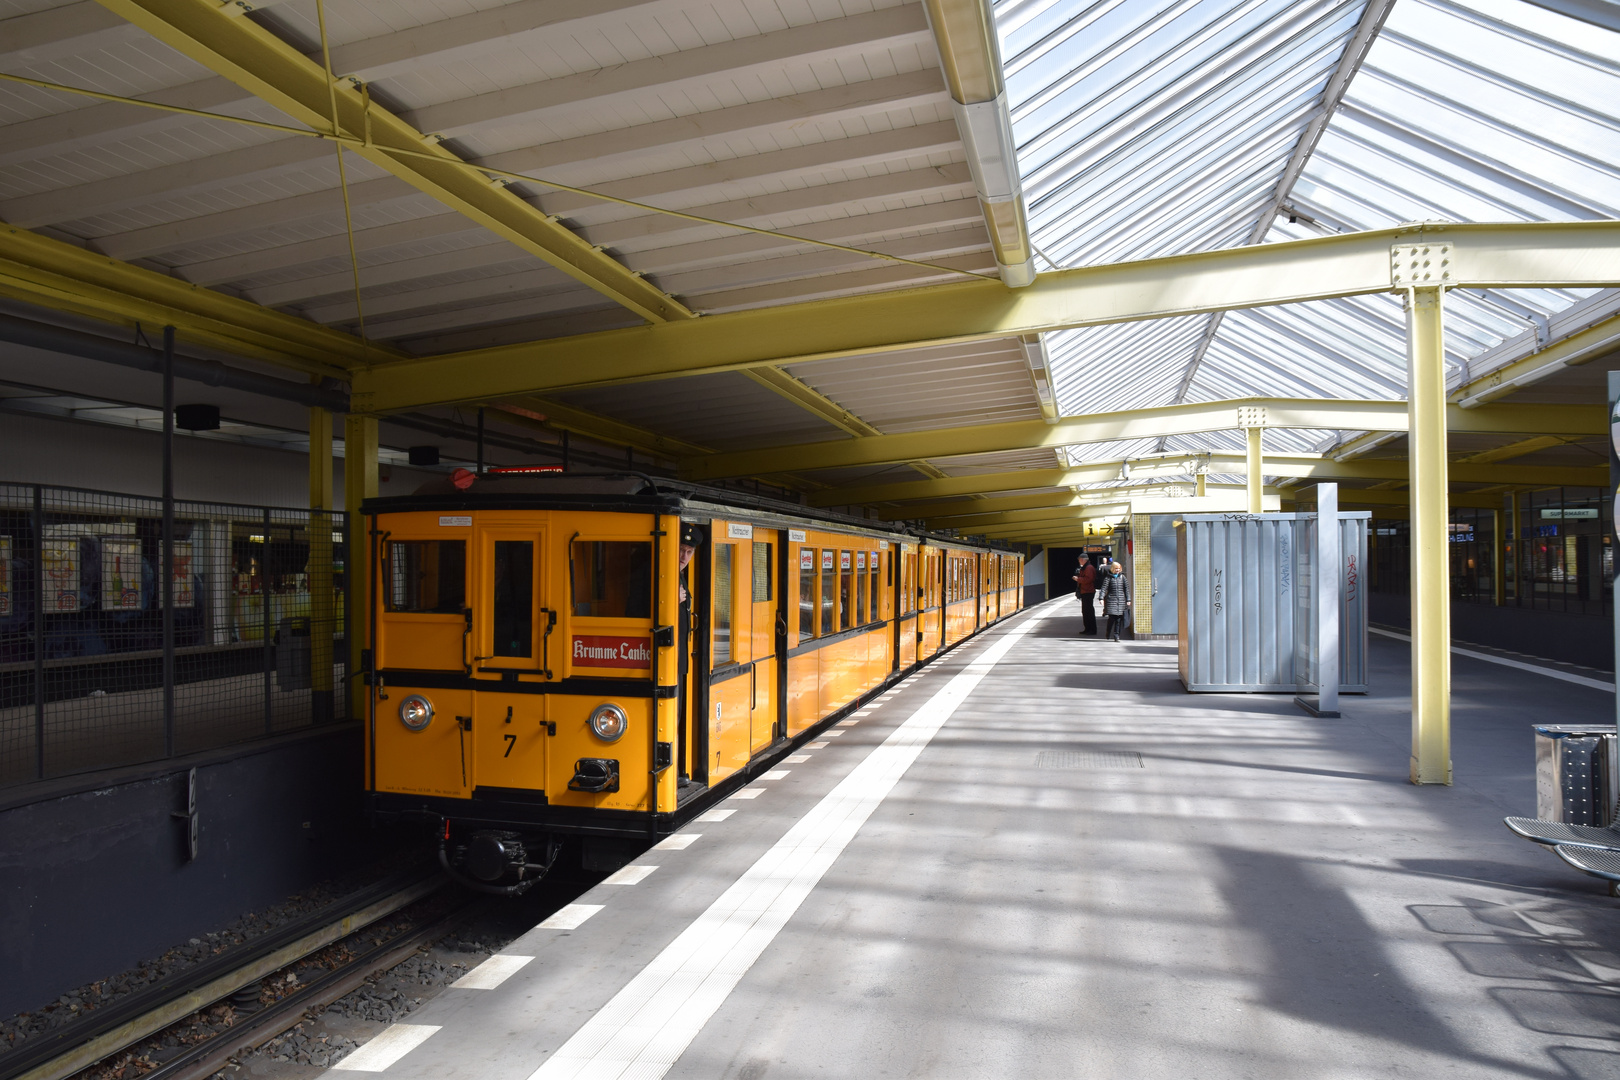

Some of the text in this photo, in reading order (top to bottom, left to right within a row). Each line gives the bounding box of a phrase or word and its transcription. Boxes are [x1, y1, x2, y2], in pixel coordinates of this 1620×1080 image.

[573, 640, 650, 660] Krumme Lanke
[504, 734, 517, 758] 7
[716, 751, 721, 773] 7
